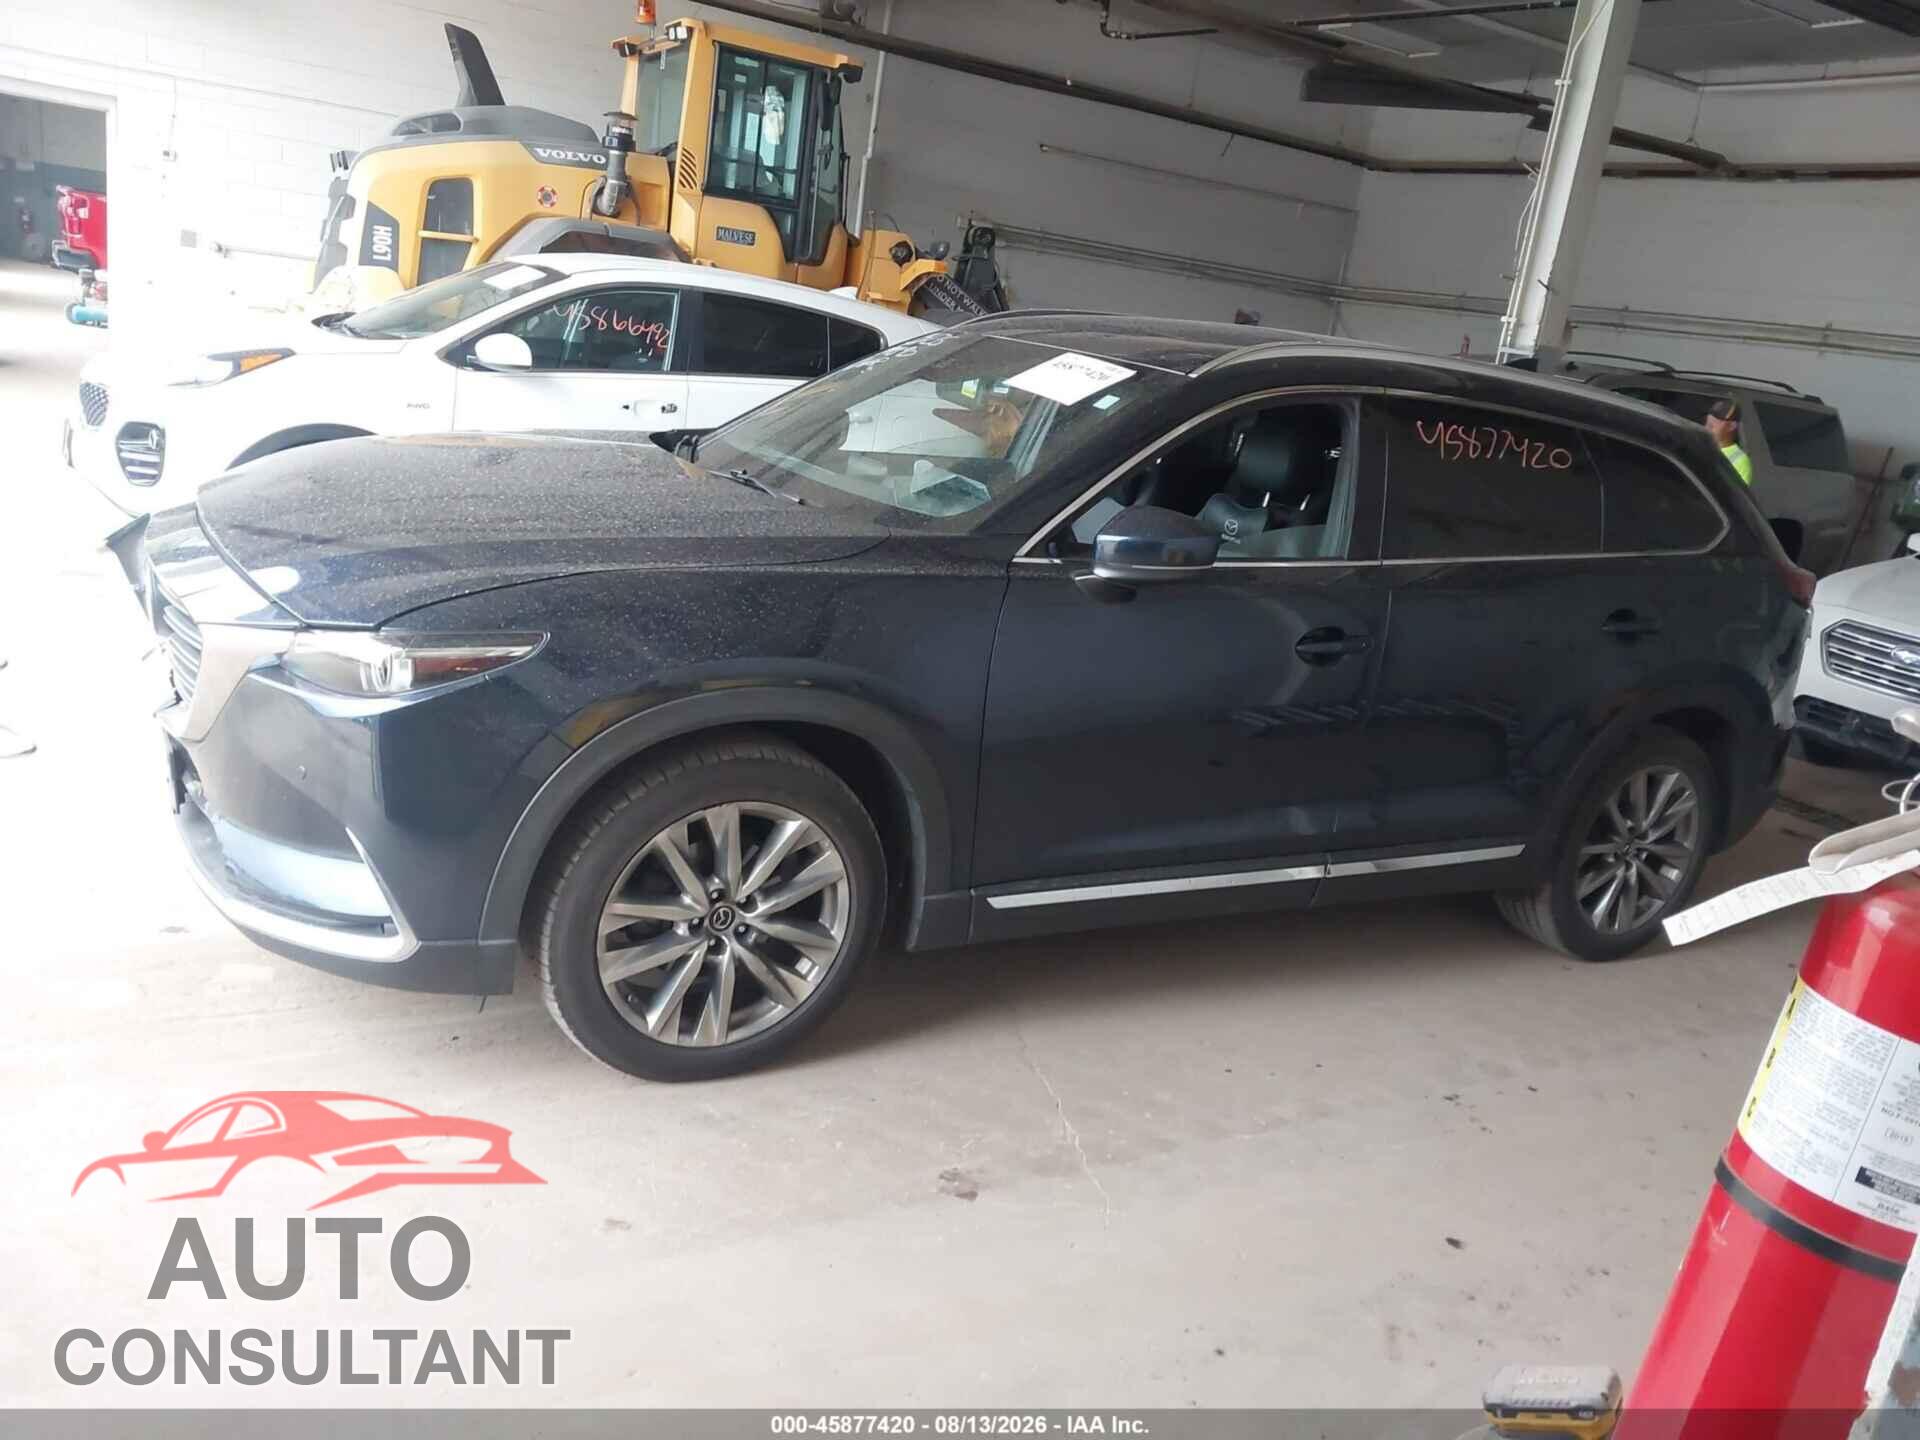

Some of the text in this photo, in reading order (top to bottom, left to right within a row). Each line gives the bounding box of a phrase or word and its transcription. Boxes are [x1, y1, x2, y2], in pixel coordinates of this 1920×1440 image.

[533, 147, 607, 165] VOLVO
[372, 224, 393, 261] L90H
[1416, 420, 1573, 468] 45877420
